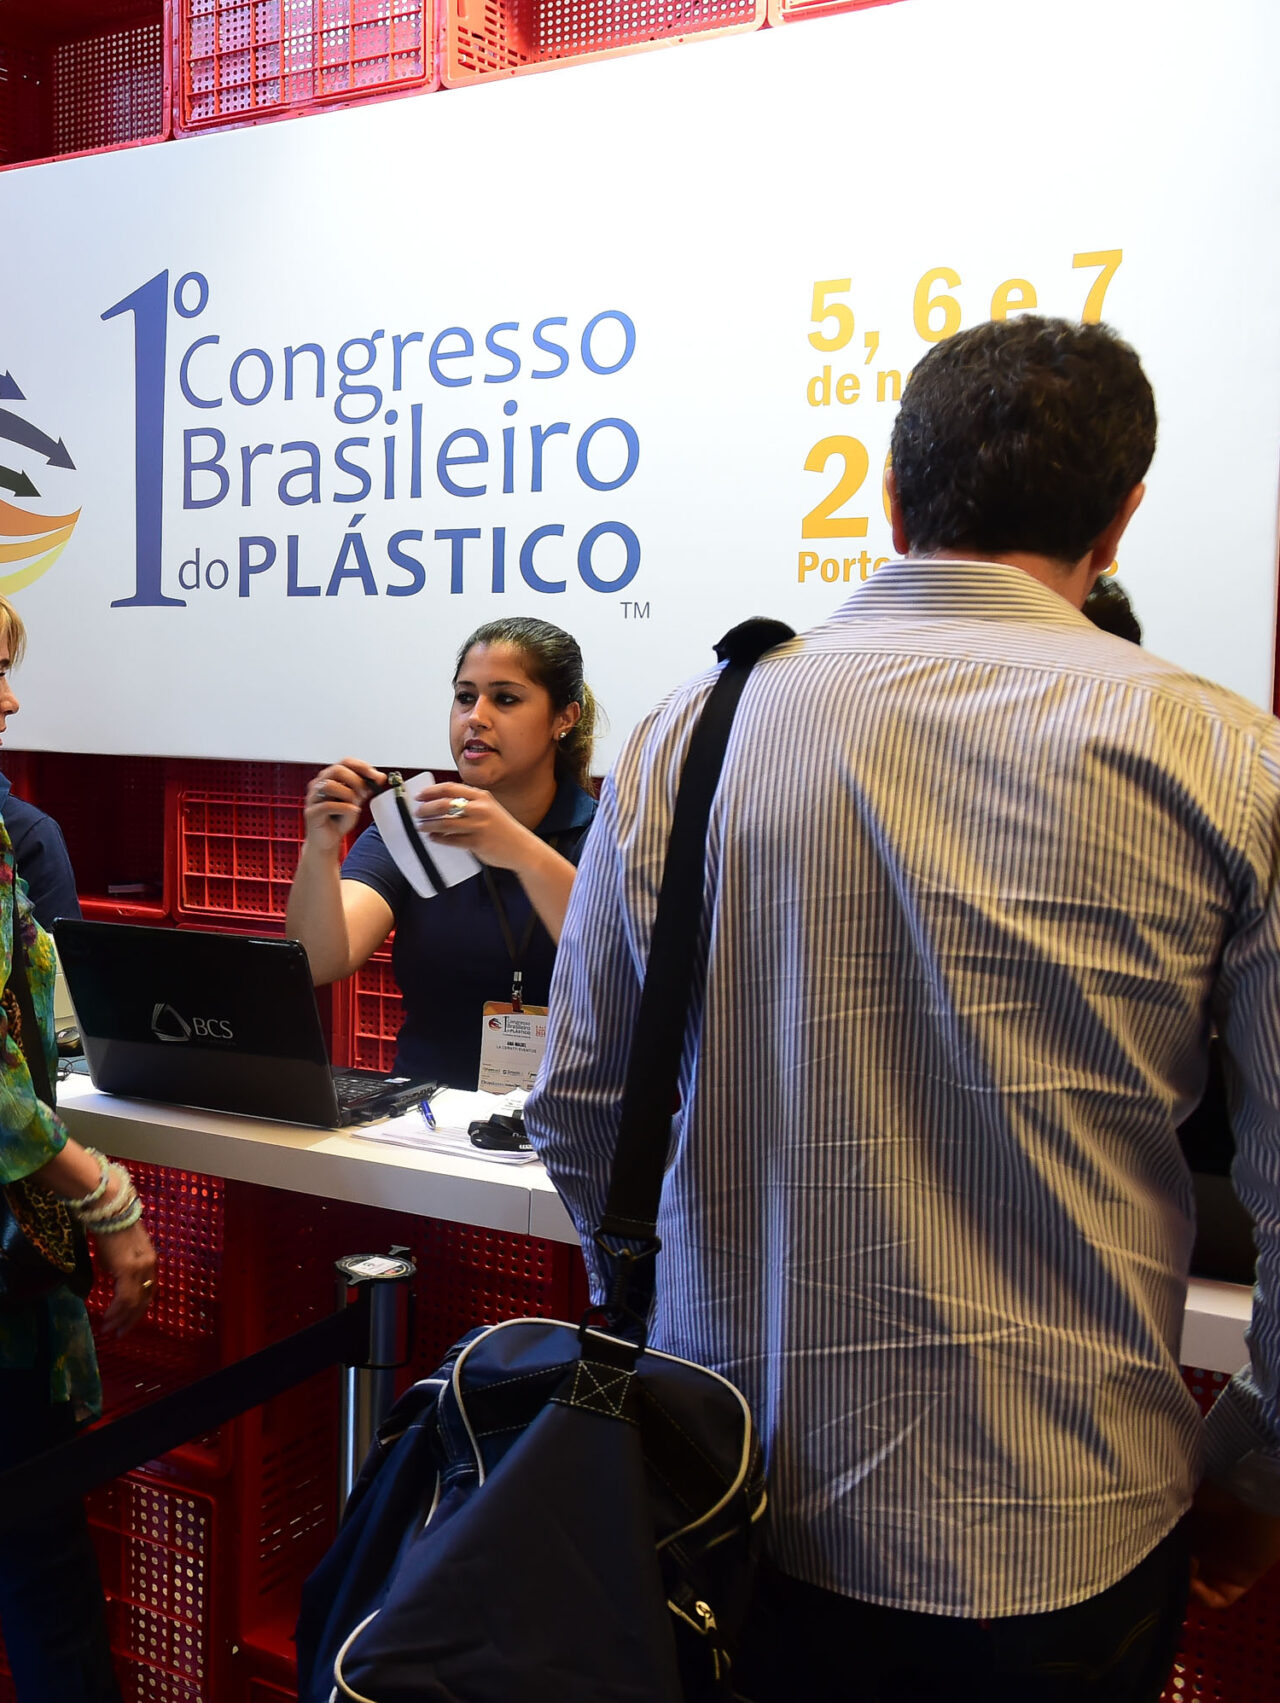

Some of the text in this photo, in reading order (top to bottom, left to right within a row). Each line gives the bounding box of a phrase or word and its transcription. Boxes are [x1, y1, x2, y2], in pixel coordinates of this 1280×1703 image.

[808, 249, 1123, 365] 5, 6 e 7
[179, 310, 637, 424] Congresso
[806, 365, 861, 407] de
[182, 400, 641, 510] Brasileiro
[178, 513, 641, 598] do PLÁSTICO
[619, 601, 651, 619] TM
[192, 1017, 234, 1040] BCS
